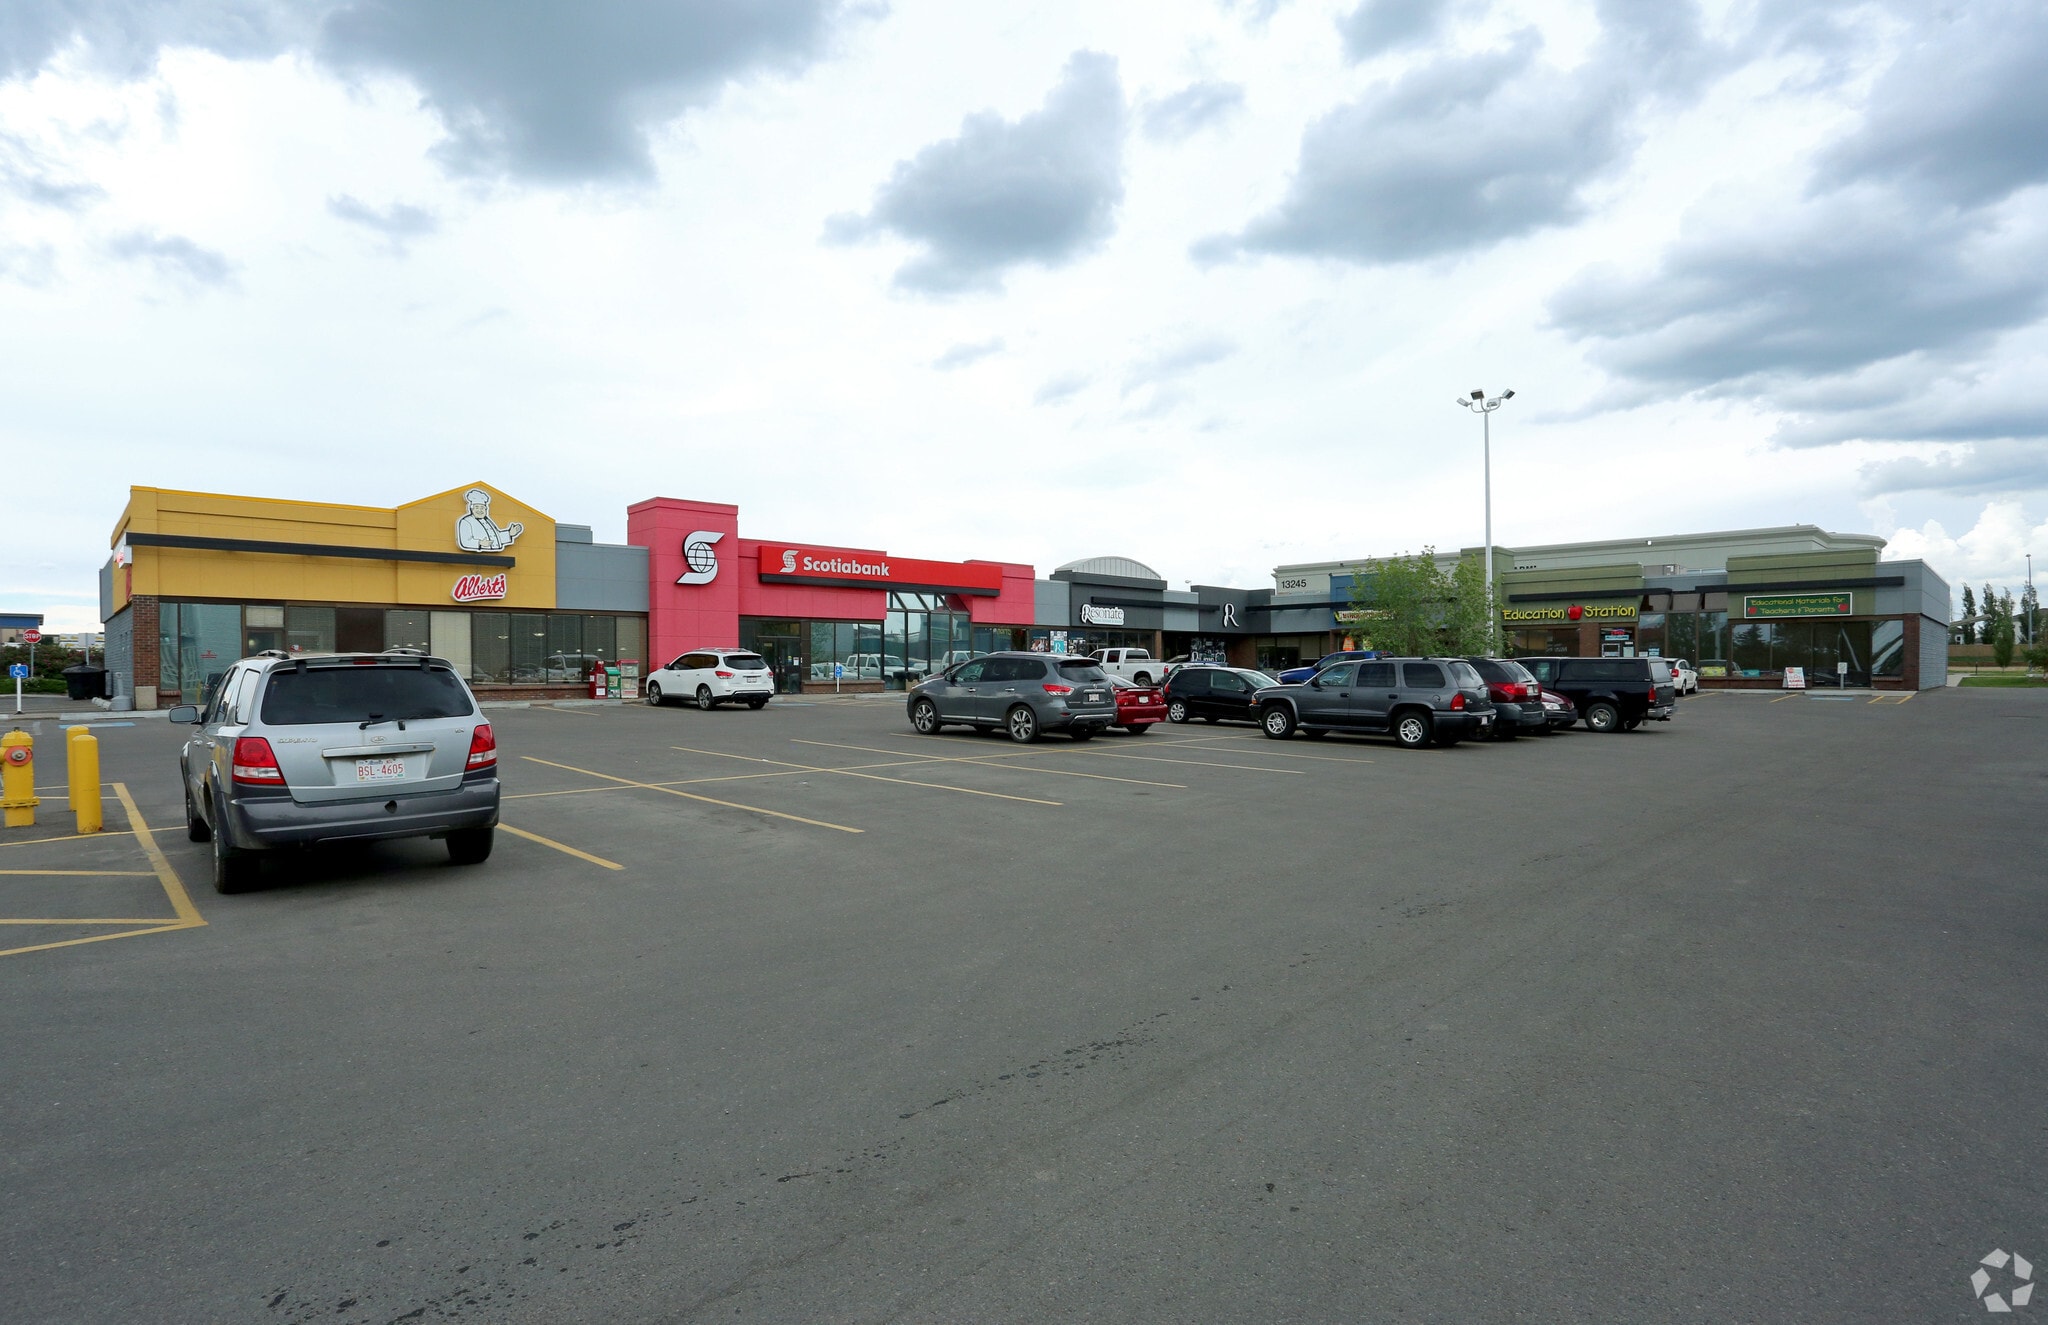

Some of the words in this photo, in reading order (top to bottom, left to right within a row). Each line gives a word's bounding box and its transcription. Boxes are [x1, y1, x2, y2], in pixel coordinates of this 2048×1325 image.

[803, 556, 890, 576] Scotiabank
[1281, 579, 1307, 589] 13245
[1082, 604, 1124, 623] Resonate
[1224, 603, 1240, 627] R
[1502, 608, 1565, 620] Education
[1584, 605, 1636, 617] Station
[358, 764, 404, 777] BSL-4605
